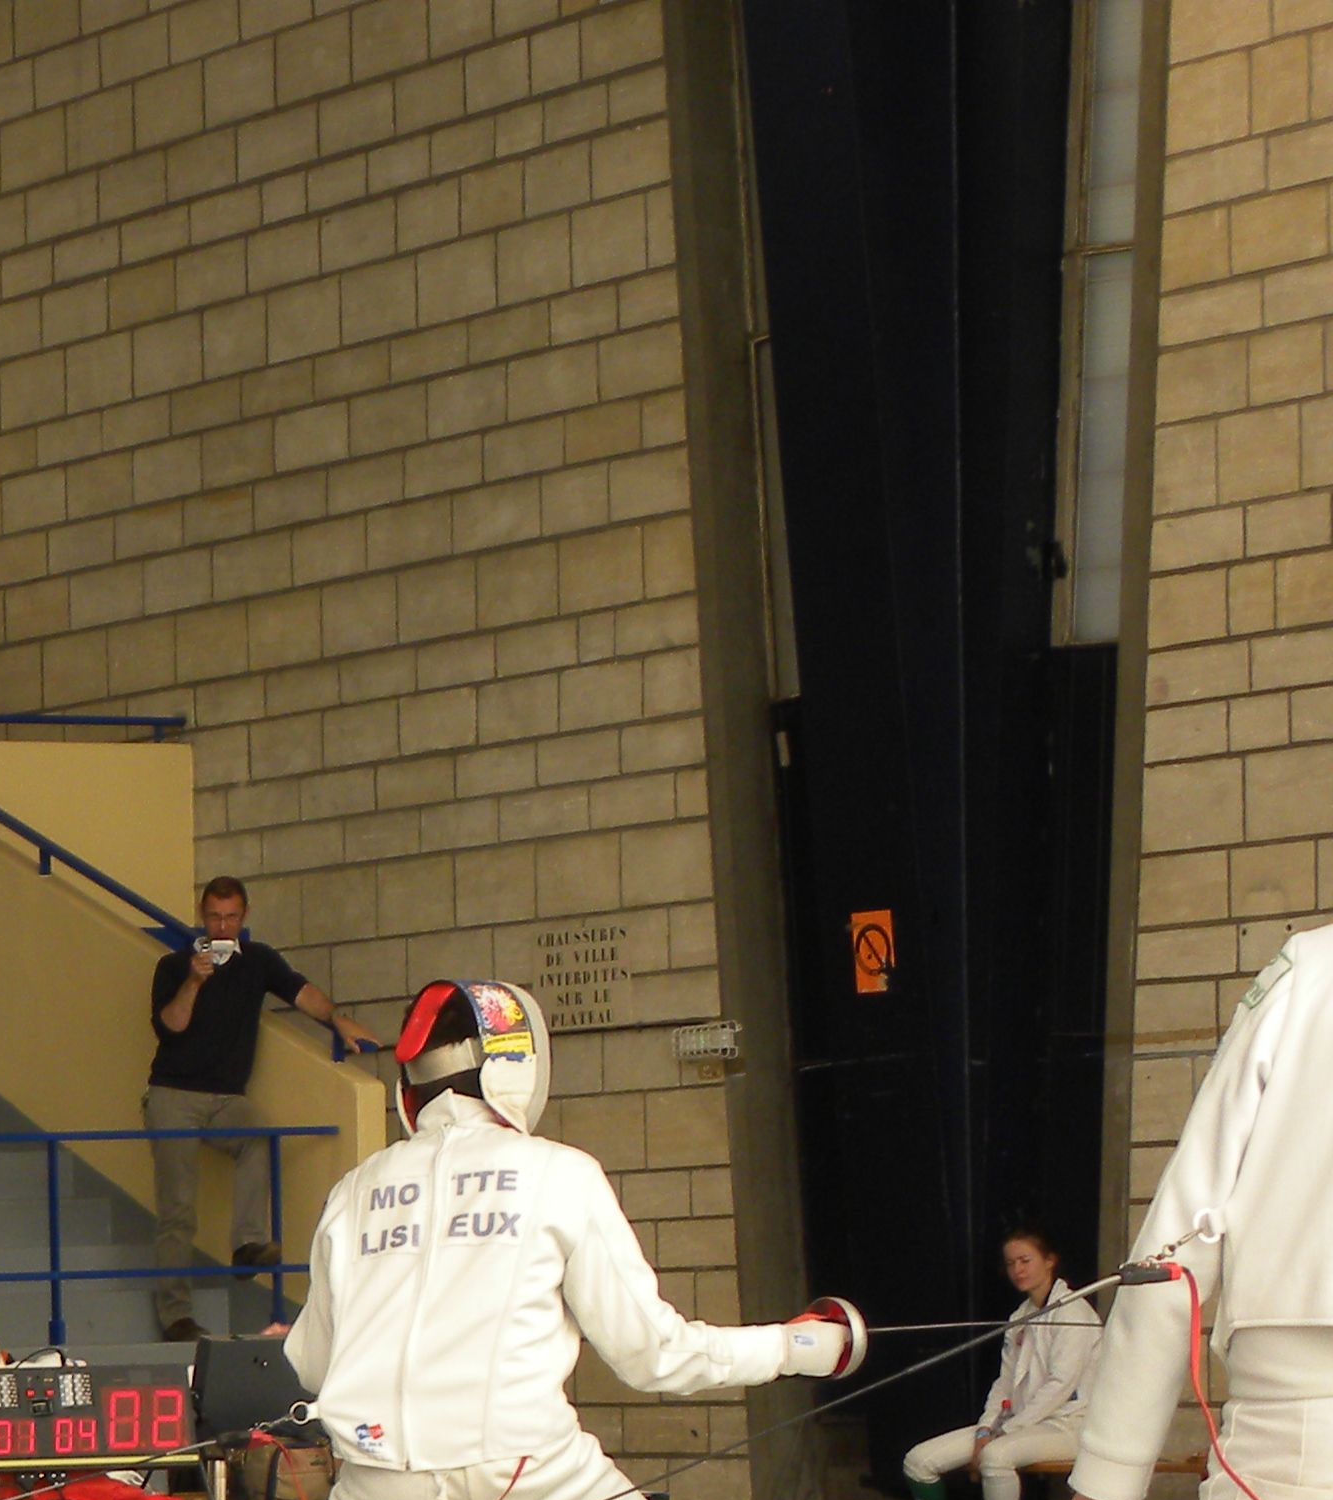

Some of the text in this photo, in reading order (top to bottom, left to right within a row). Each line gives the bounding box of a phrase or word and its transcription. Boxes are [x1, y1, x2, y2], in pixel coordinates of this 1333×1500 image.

[537, 926, 627, 947] CHAUSSURES
[546, 947, 618, 968] DE VILLE
[540, 967, 628, 988] INTERDITES
[557, 988, 611, 1007] SUR LE
[551, 1008, 613, 1028] PLATEAU
[109, 1389, 183, 1450] 02
